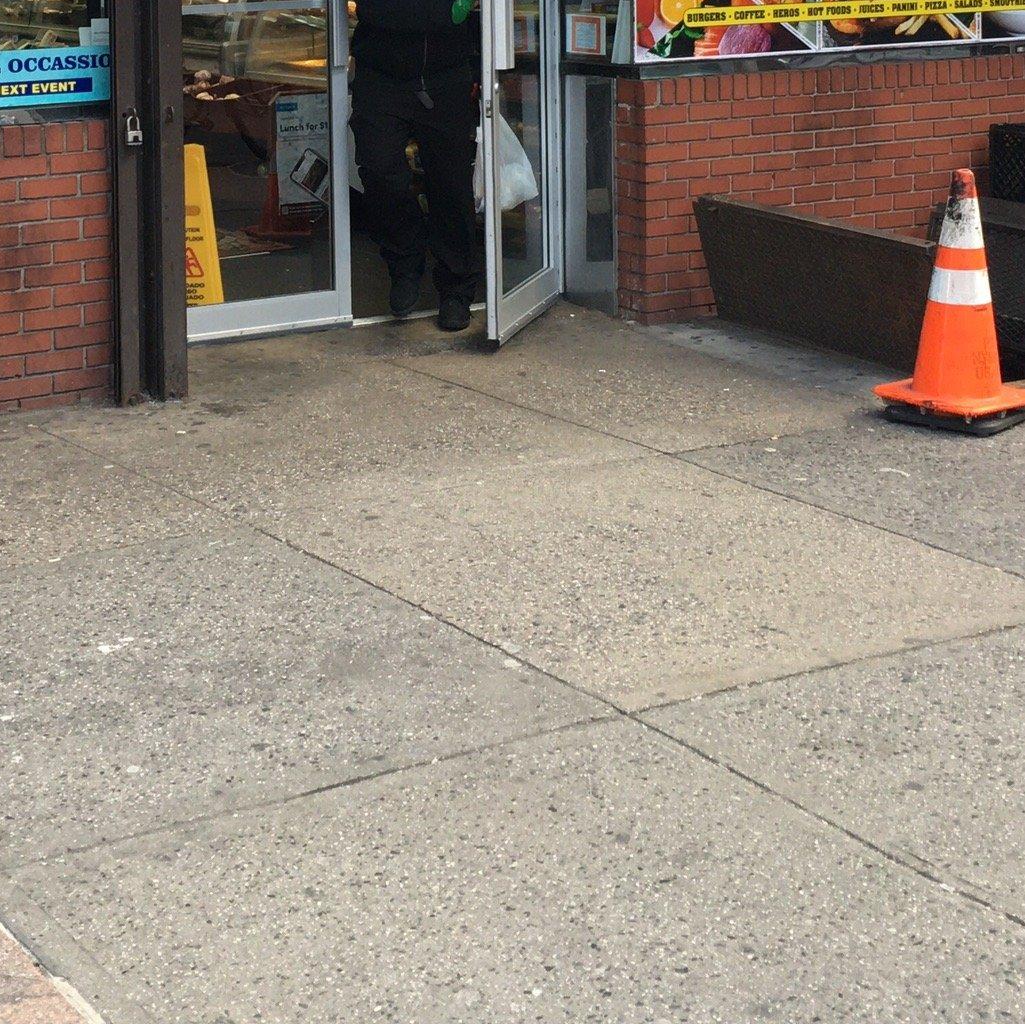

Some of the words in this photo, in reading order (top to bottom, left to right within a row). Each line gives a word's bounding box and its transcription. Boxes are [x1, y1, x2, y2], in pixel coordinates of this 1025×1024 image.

[686, 12, 727, 23] BURGERS
[733, 9, 766, 21] COFFEE
[772, 7, 800, 19] HEROS
[807, 6, 824, 17] HOT
[825, 5, 852, 16] FOODS
[858, 3, 885, 14] JUICES
[891, 1, 918, 12] PANINI
[924, 0, 948, 11] PIZZA
[31, 81, 77, 94] EVENT
[279, 123, 304, 133] Lunch
[306, 122, 318, 131] for
